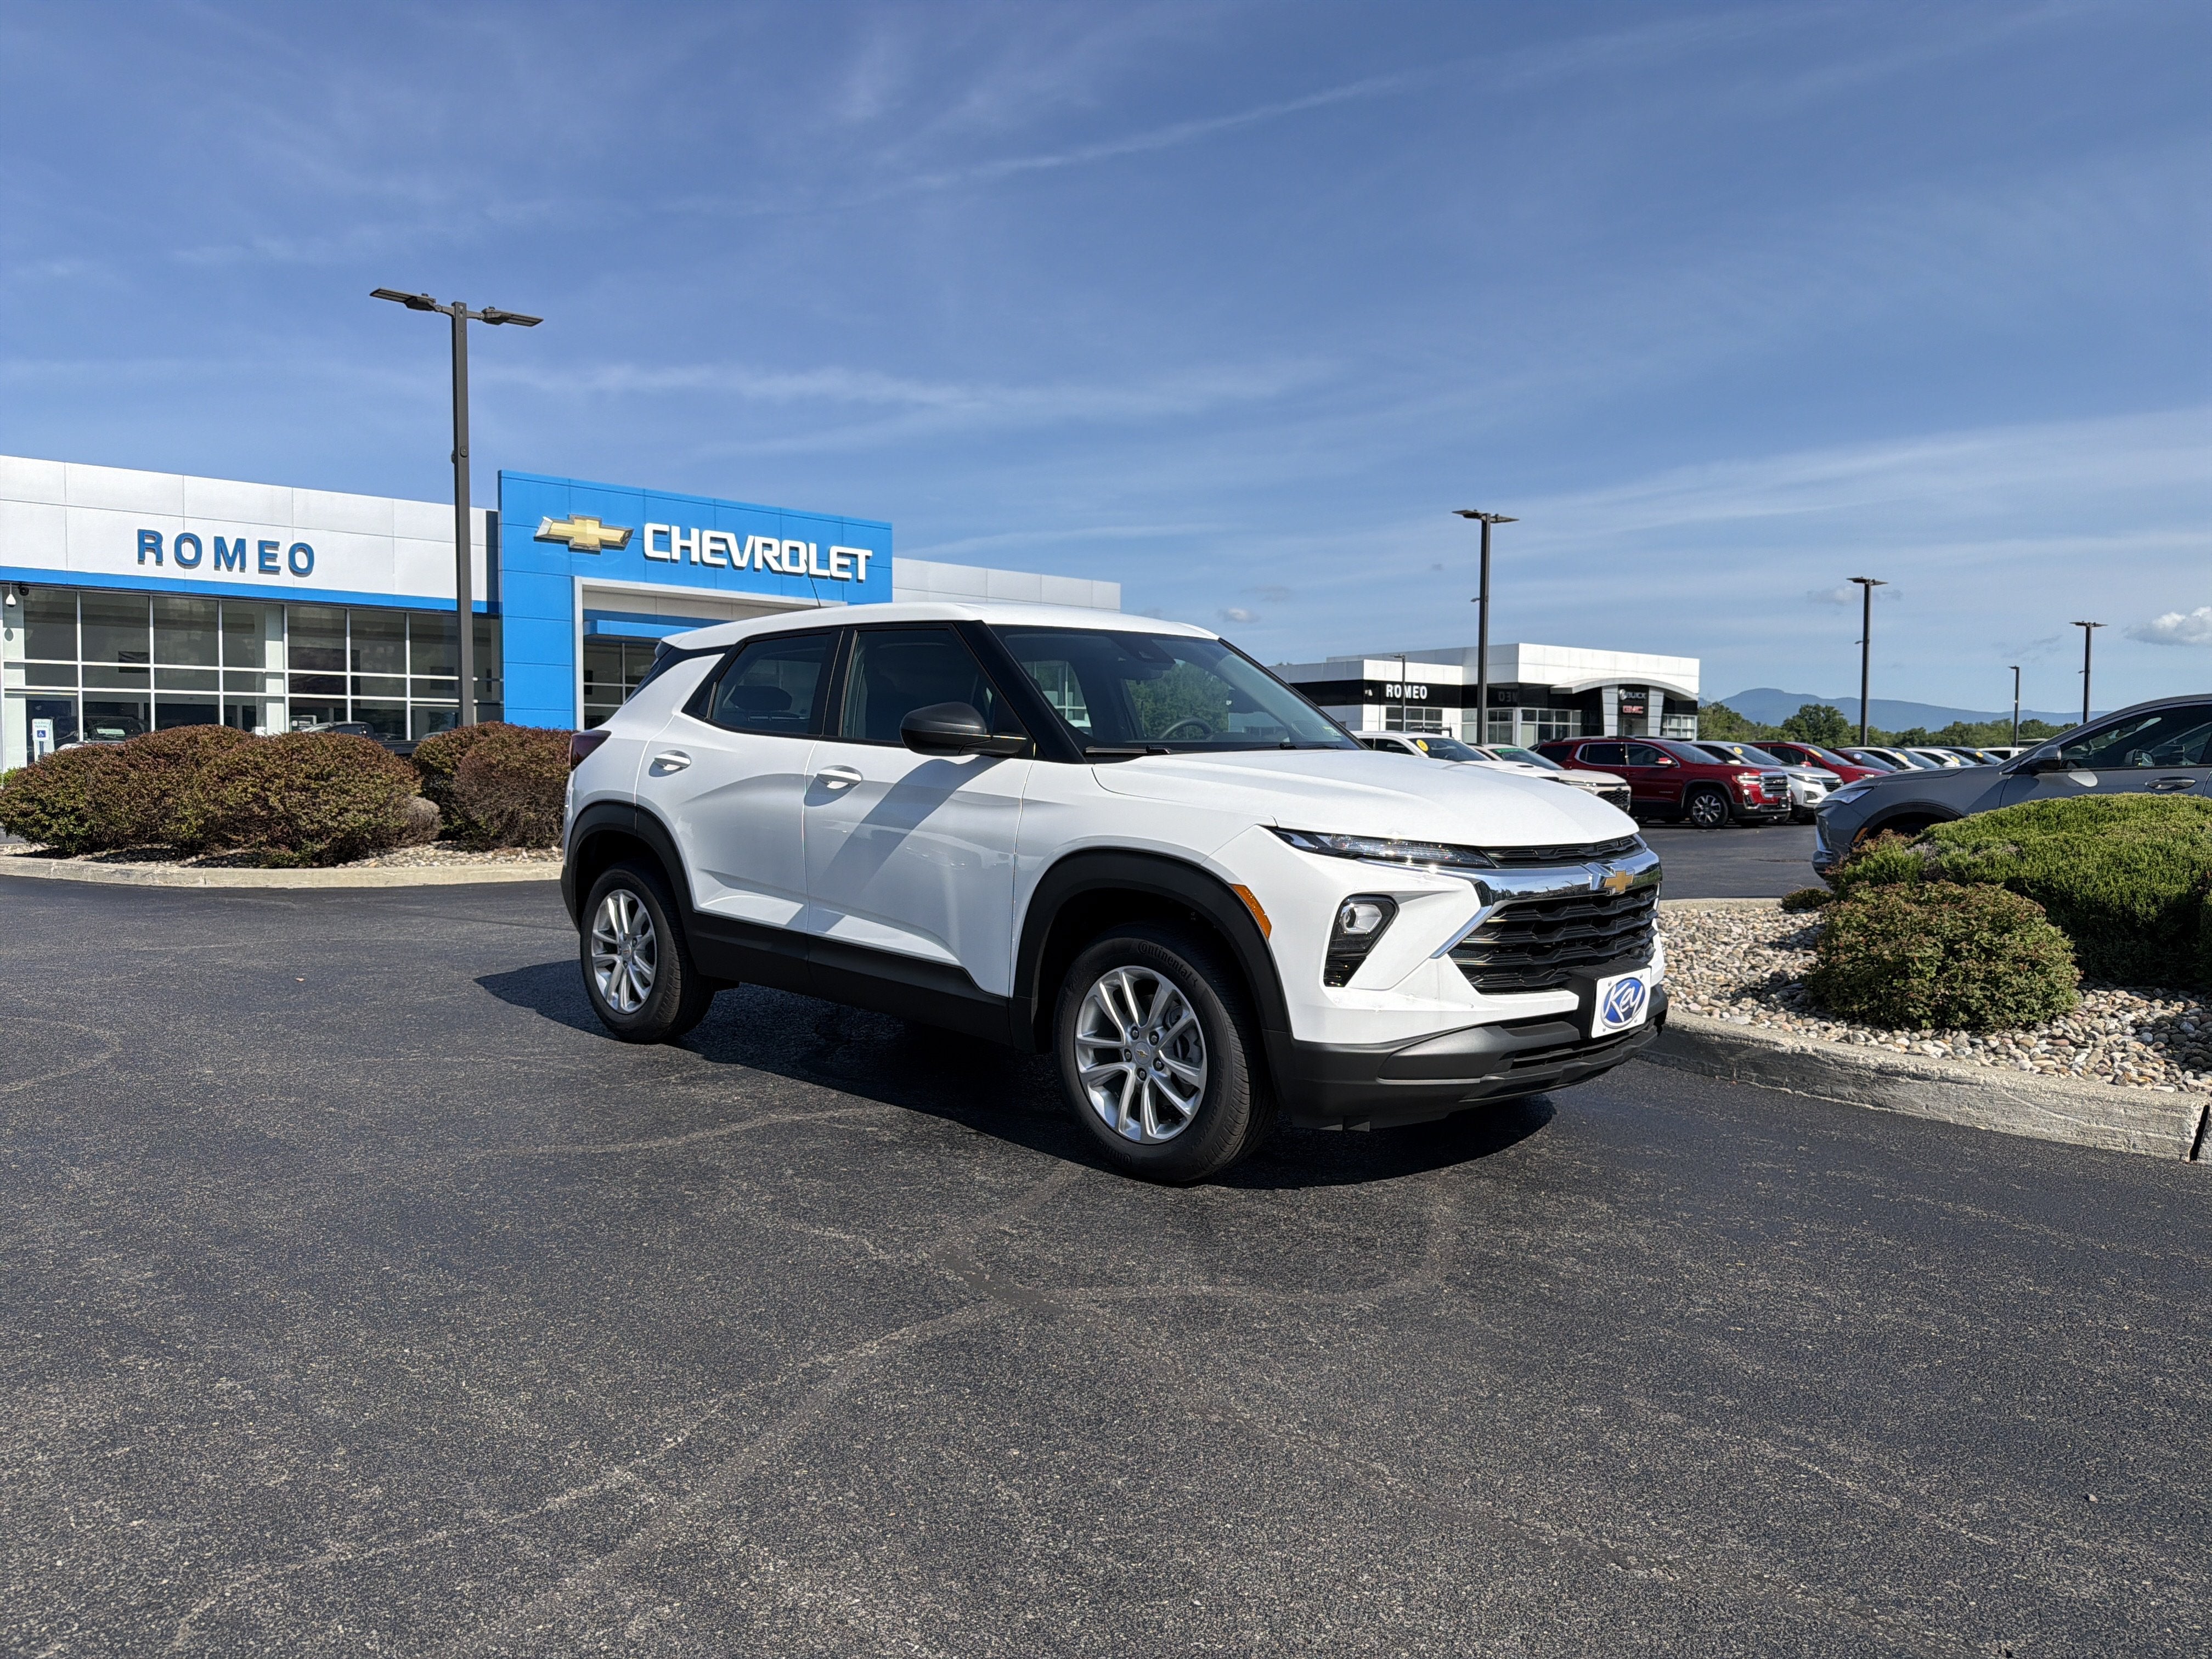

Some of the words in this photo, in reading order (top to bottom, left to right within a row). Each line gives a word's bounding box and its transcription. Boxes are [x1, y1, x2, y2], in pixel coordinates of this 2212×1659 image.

[137, 529, 315, 577] ROMEO
[644, 523, 873, 583] CHEVROLET
[1386, 684, 1427, 699] ROMEO
[1622, 705, 1644, 714] GMC
[1137, 941, 1193, 981] Continental
[1604, 982, 1643, 1023] Key
